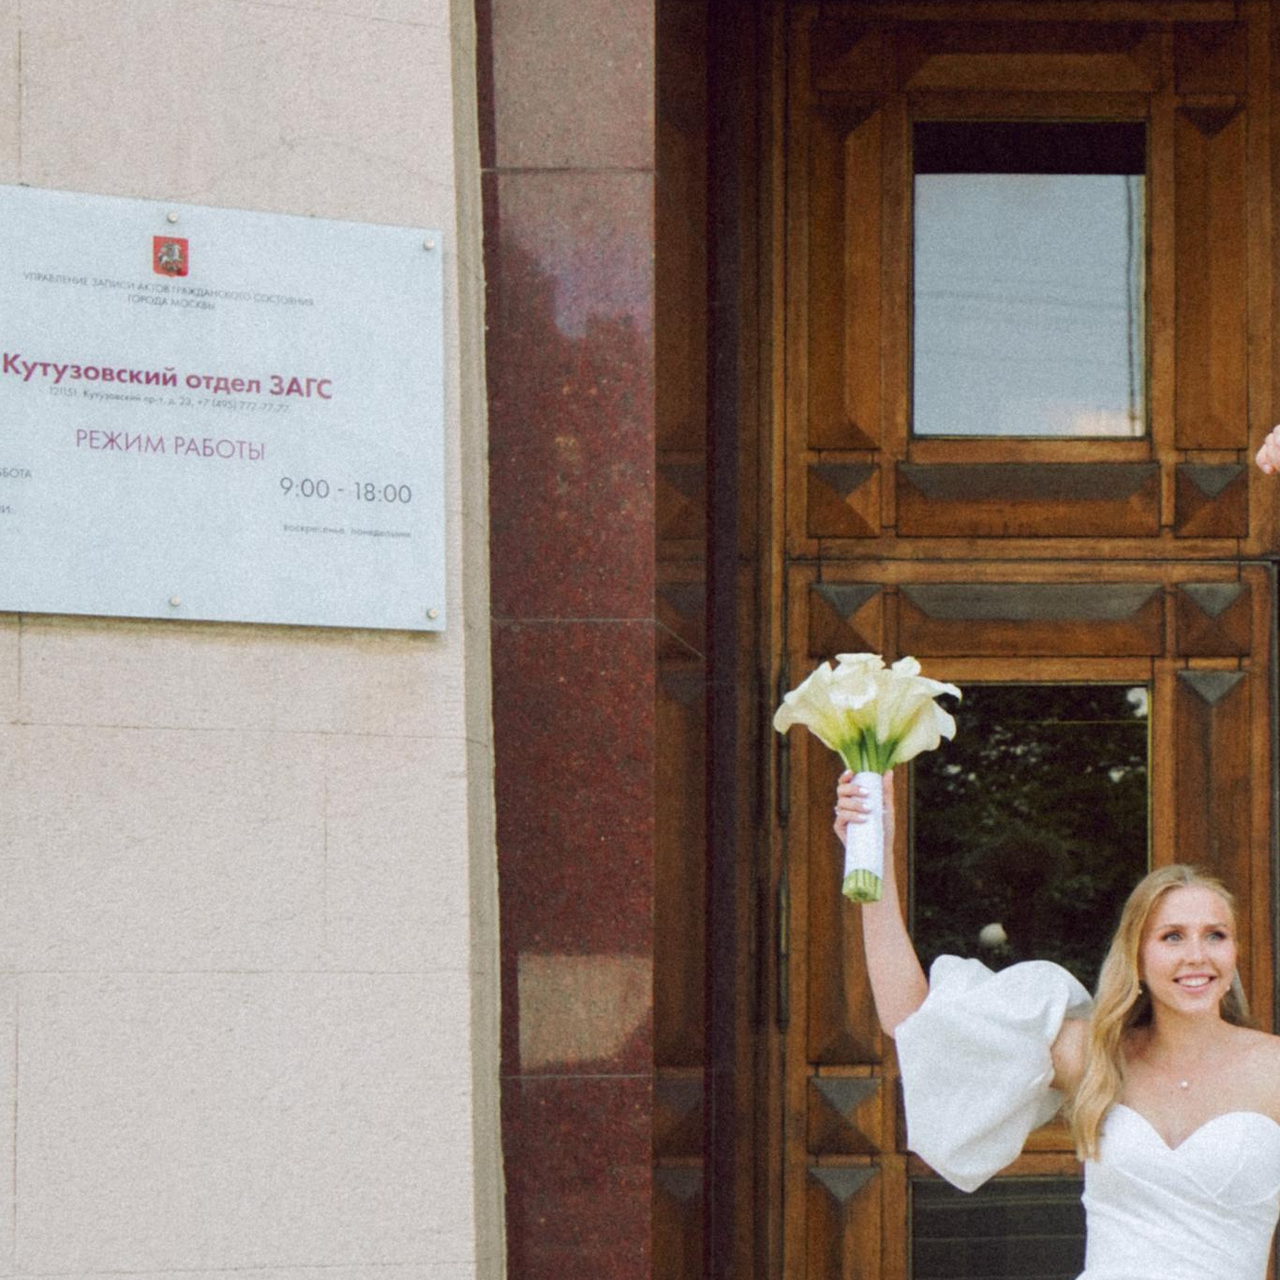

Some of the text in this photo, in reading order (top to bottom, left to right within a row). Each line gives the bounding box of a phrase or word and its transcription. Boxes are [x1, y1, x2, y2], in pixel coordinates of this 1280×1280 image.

[127, 294, 168, 306] ГОРОДА
[2, 352, 332, 399] Кутузовский отдел ЗАГС
[76, 428, 265, 461] РЕЖИМ РАБОТЫ
[279, 476, 330, 499] 9:00
[354, 480, 412, 504] 18:00
